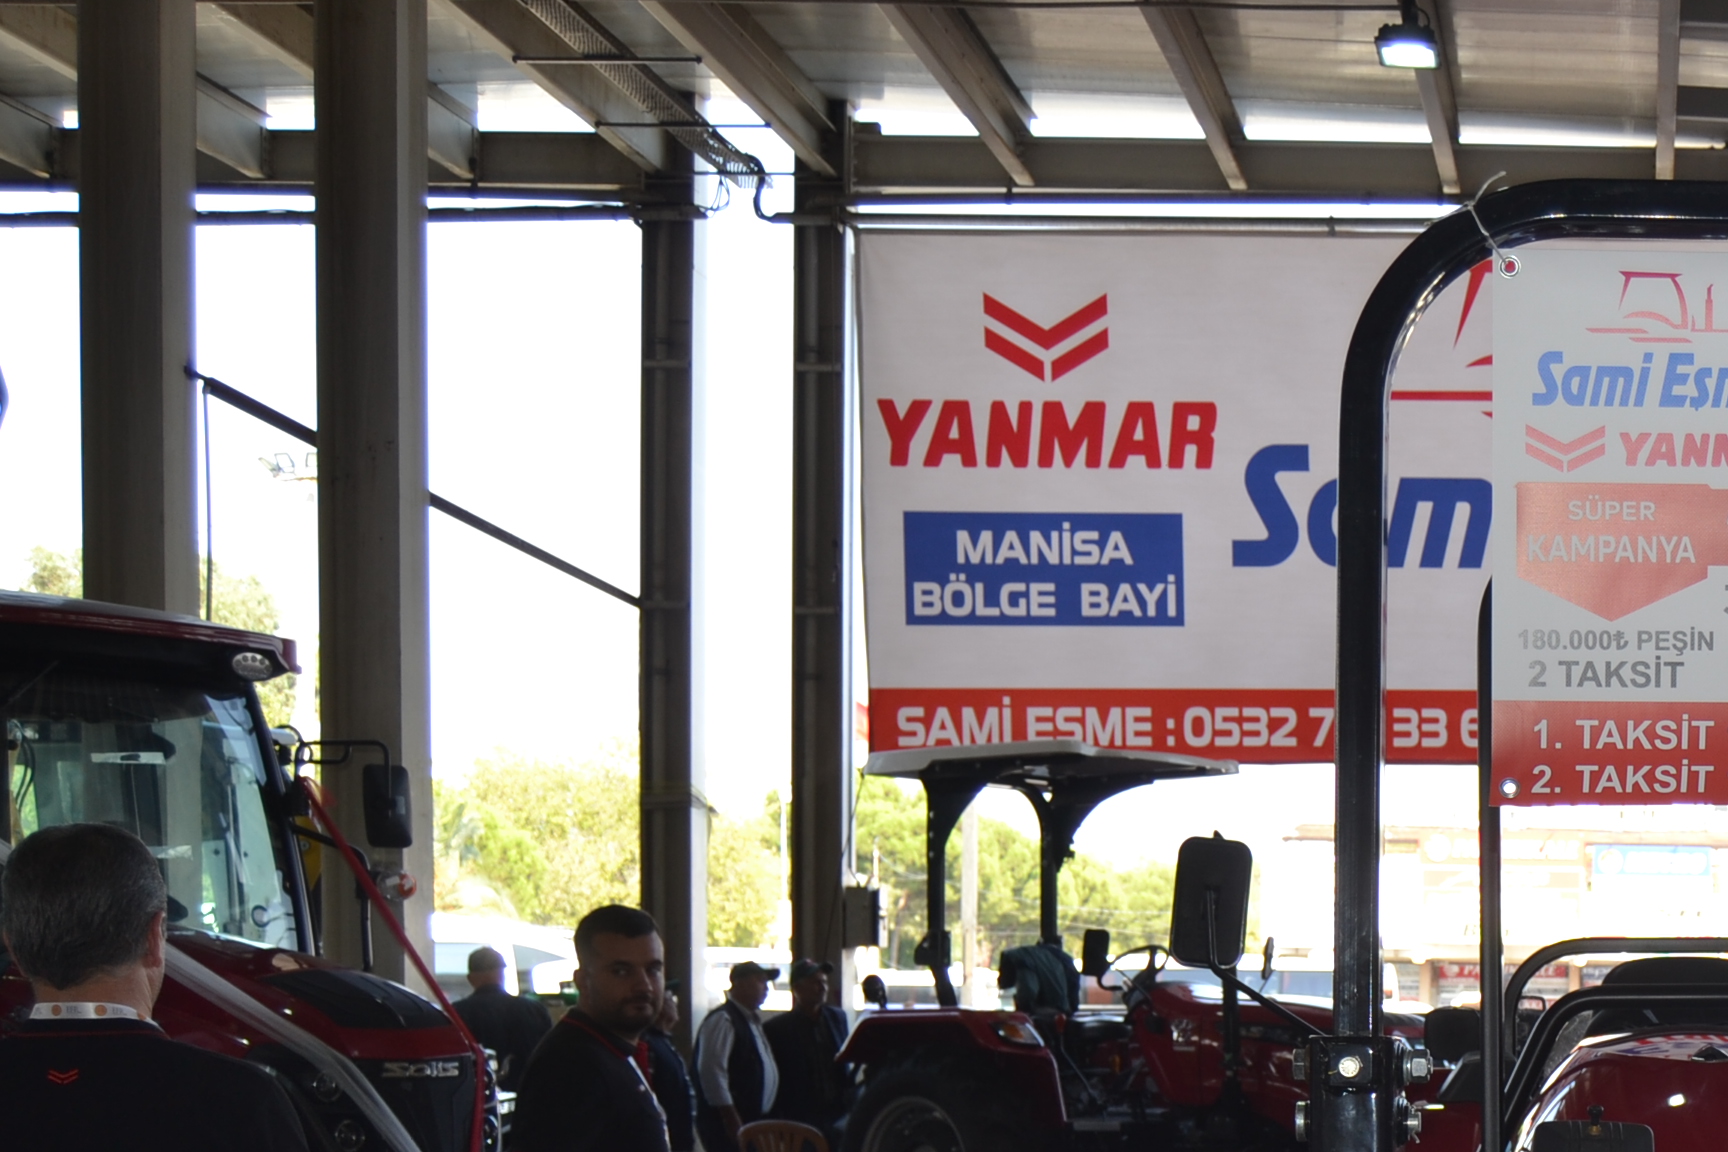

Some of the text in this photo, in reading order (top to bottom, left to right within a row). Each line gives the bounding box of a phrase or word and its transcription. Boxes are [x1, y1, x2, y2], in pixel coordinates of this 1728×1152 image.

[1532, 351, 1653, 408] Sami
[877, 398, 1217, 470] YANMAR
[1231, 443, 1493, 569] Sm
[1568, 496, 1655, 522] SÜPER
[955, 521, 1133, 566] MANİSA
[1526, 534, 1696, 564] KAMPANYA
[913, 572, 1177, 618] BÖLGE BAYİ
[1636, 627, 1715, 656] PEŞİN
[1528, 656, 1685, 689] 2 TAKSİT
[897, 696, 1012, 746] SAMİ
[1183, 706, 1298, 747] 0532
[1392, 709, 1448, 748] 33
[1533, 720, 1562, 751] 1.
[1576, 714, 1715, 752] TAKSİT
[1531, 765, 1562, 794] 2.
[1576, 758, 1715, 795] TAKSİT
